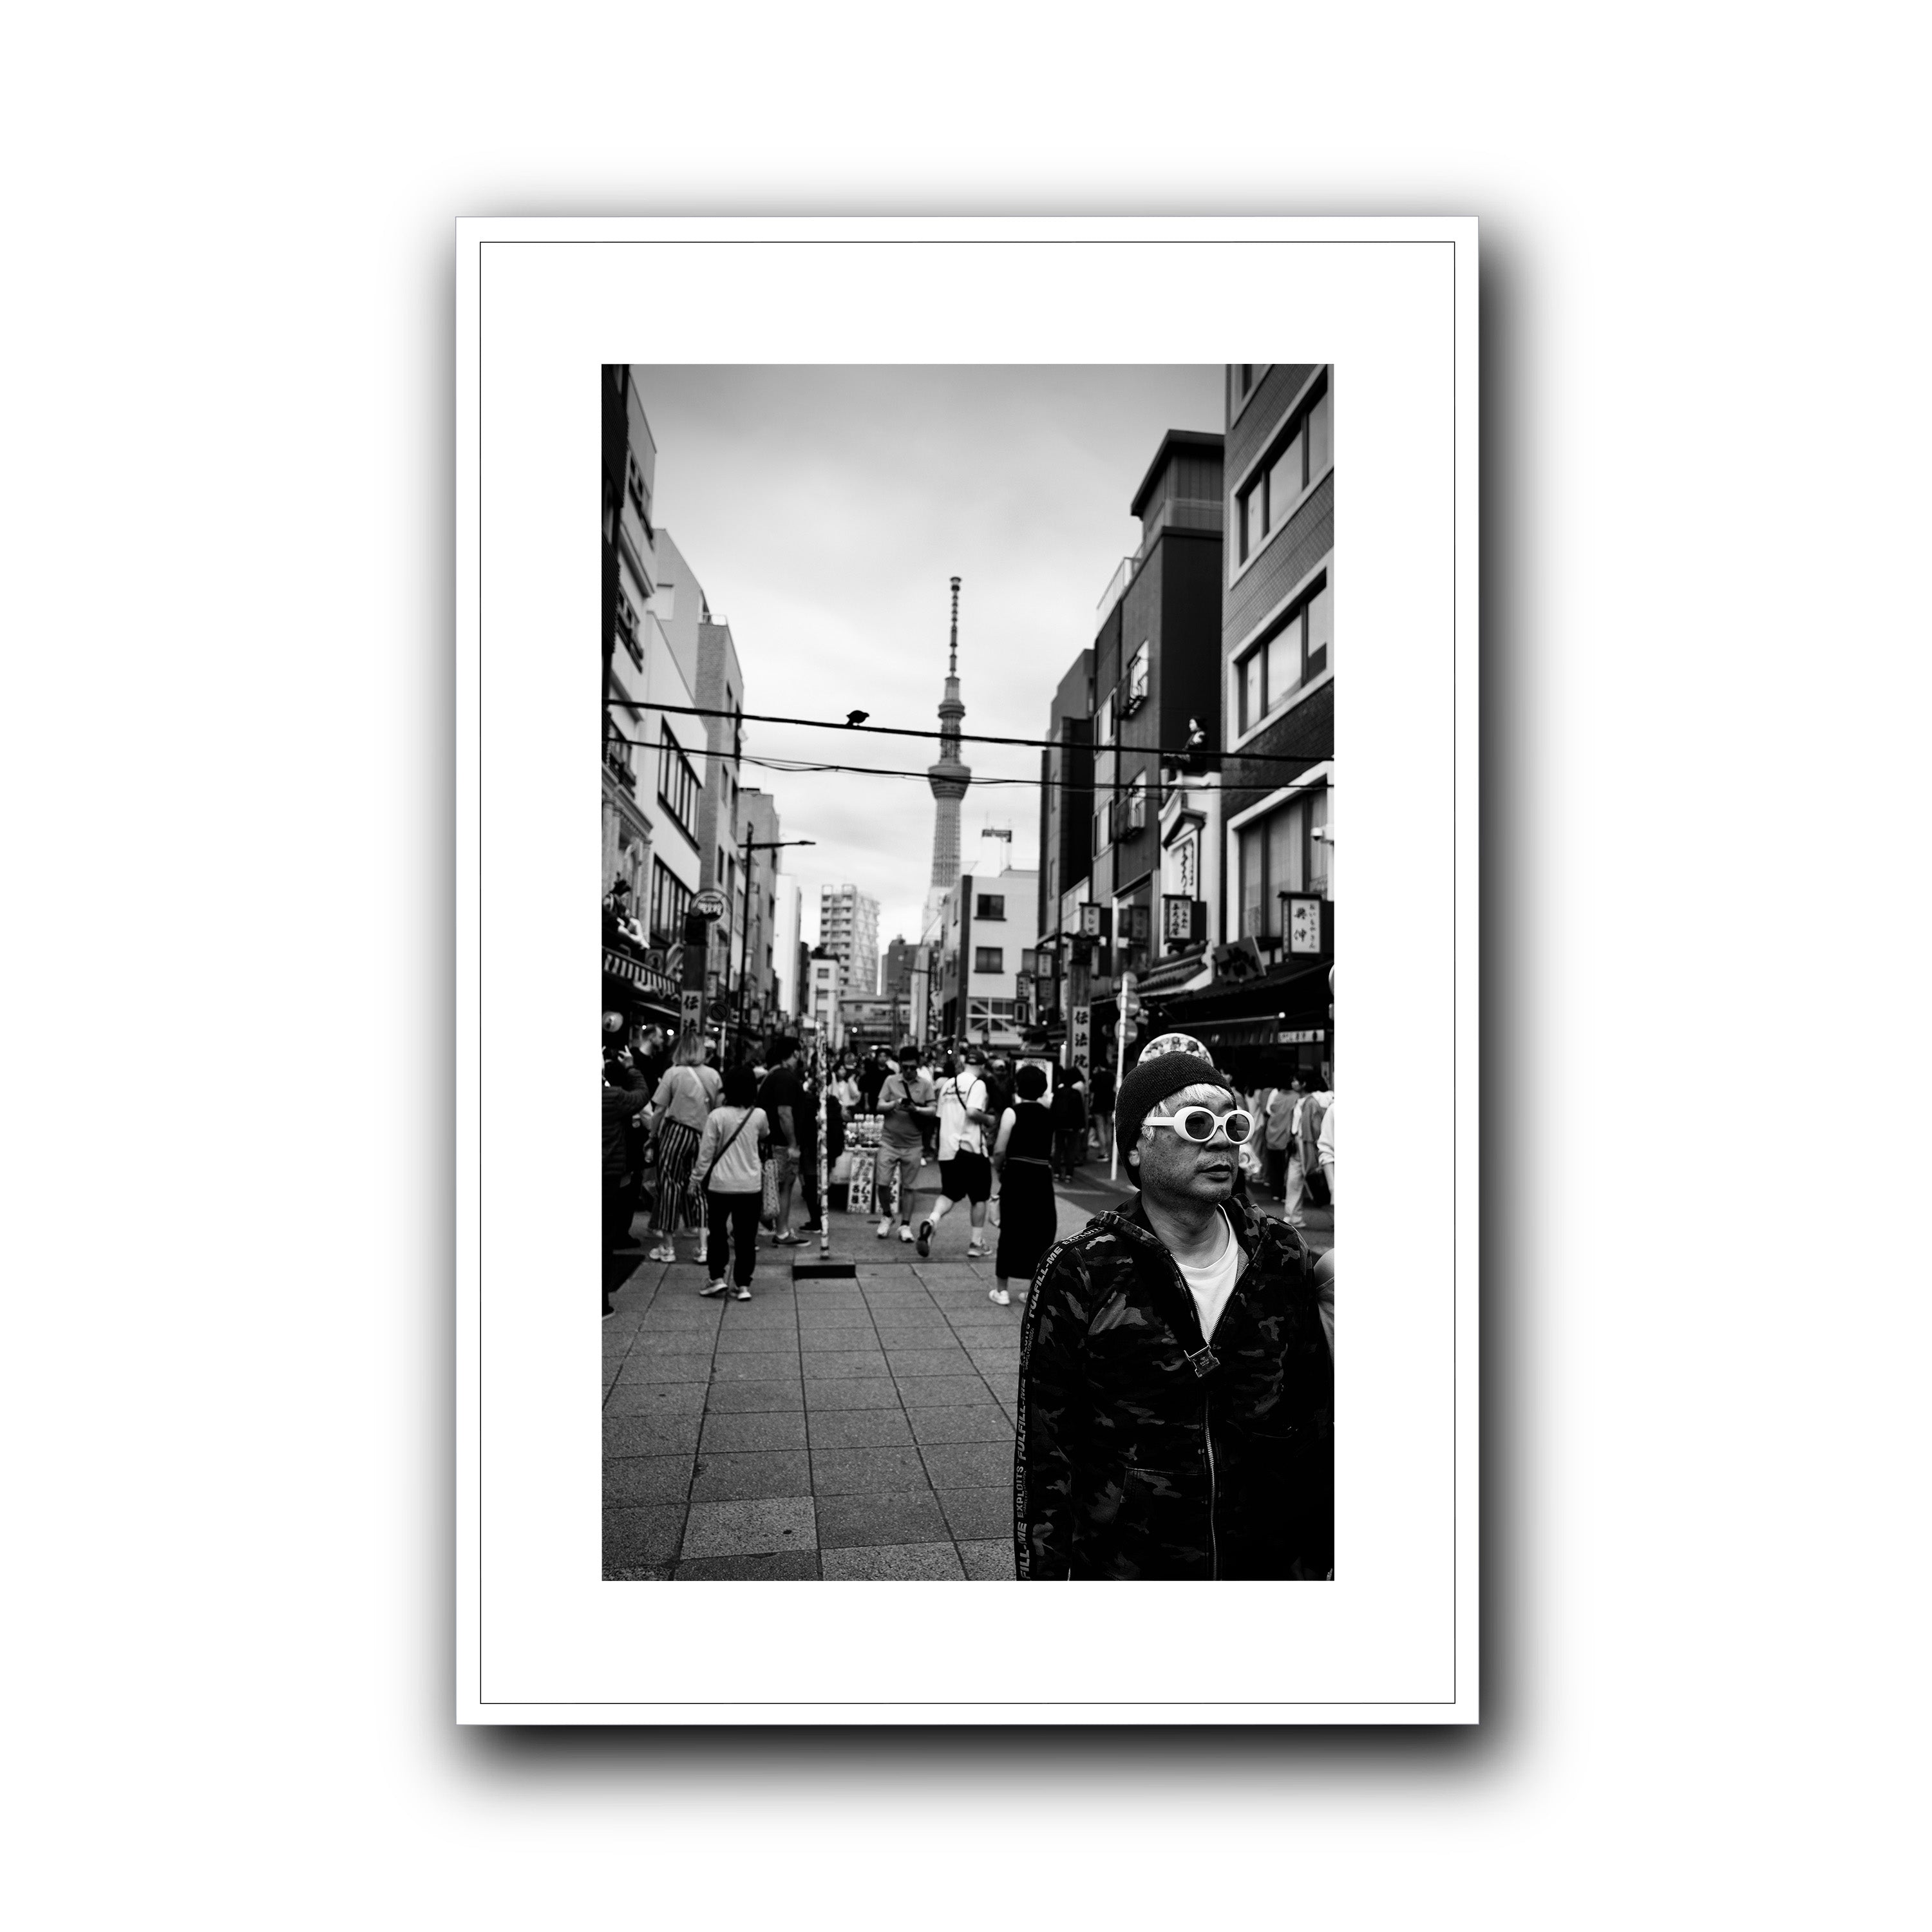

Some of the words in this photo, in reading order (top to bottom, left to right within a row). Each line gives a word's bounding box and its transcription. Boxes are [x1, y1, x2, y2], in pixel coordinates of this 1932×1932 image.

[1074, 1010, 1088, 1068] 伝法院
[1028, 1246, 1063, 1318] FULFILL-ME
[1018, 1378, 1027, 1461] FULFILL-ME
[1016, 1466, 1025, 1518] EXPLOITS
